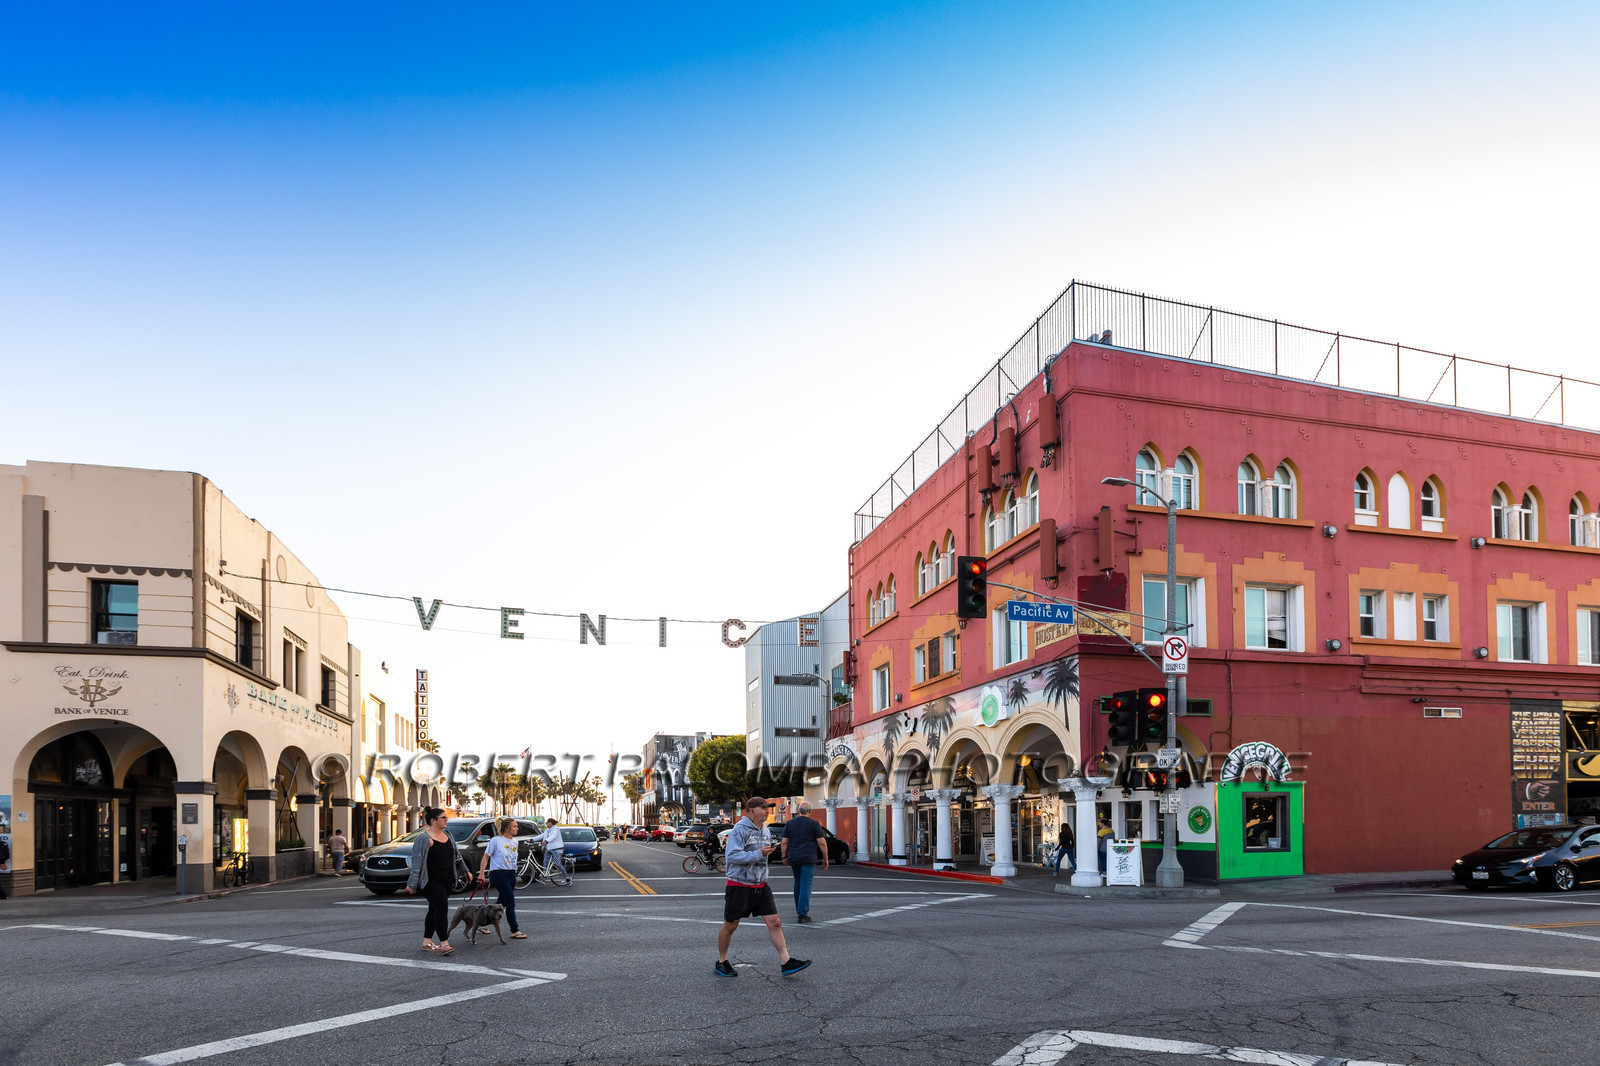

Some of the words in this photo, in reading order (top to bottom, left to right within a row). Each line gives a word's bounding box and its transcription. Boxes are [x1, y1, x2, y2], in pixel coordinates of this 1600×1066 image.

[1013, 605, 1052, 618] Pacific
[1055, 611, 1069, 619] Av
[413, 597, 819, 648] VENICE
[54, 665, 82, 678] Eat.
[88, 666, 129, 679] Drink.
[54, 707, 82, 715] BANK
[247, 682, 288, 711] BANK
[302, 706, 339, 732] VENICE
[418, 671, 428, 740] TATTOO
[1522, 802, 1555, 810] ENTER
